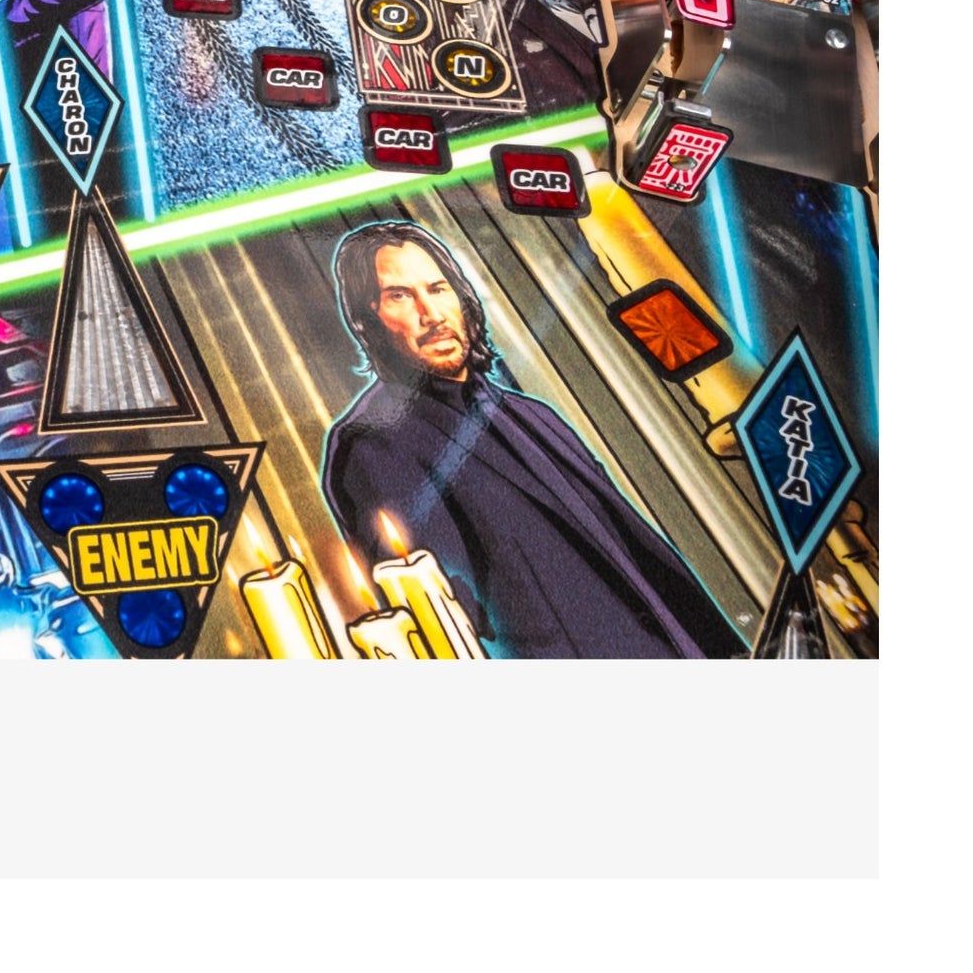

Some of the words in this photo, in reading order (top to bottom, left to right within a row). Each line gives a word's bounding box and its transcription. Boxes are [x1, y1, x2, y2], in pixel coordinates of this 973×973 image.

[268, 69, 322, 87] CAR
[56, 58, 91, 154] CHARON
[377, 129, 432, 149] CAR
[512, 170, 569, 192] CAR
[780, 396, 814, 504] KATIA
[77, 524, 211, 587] ENEMY
